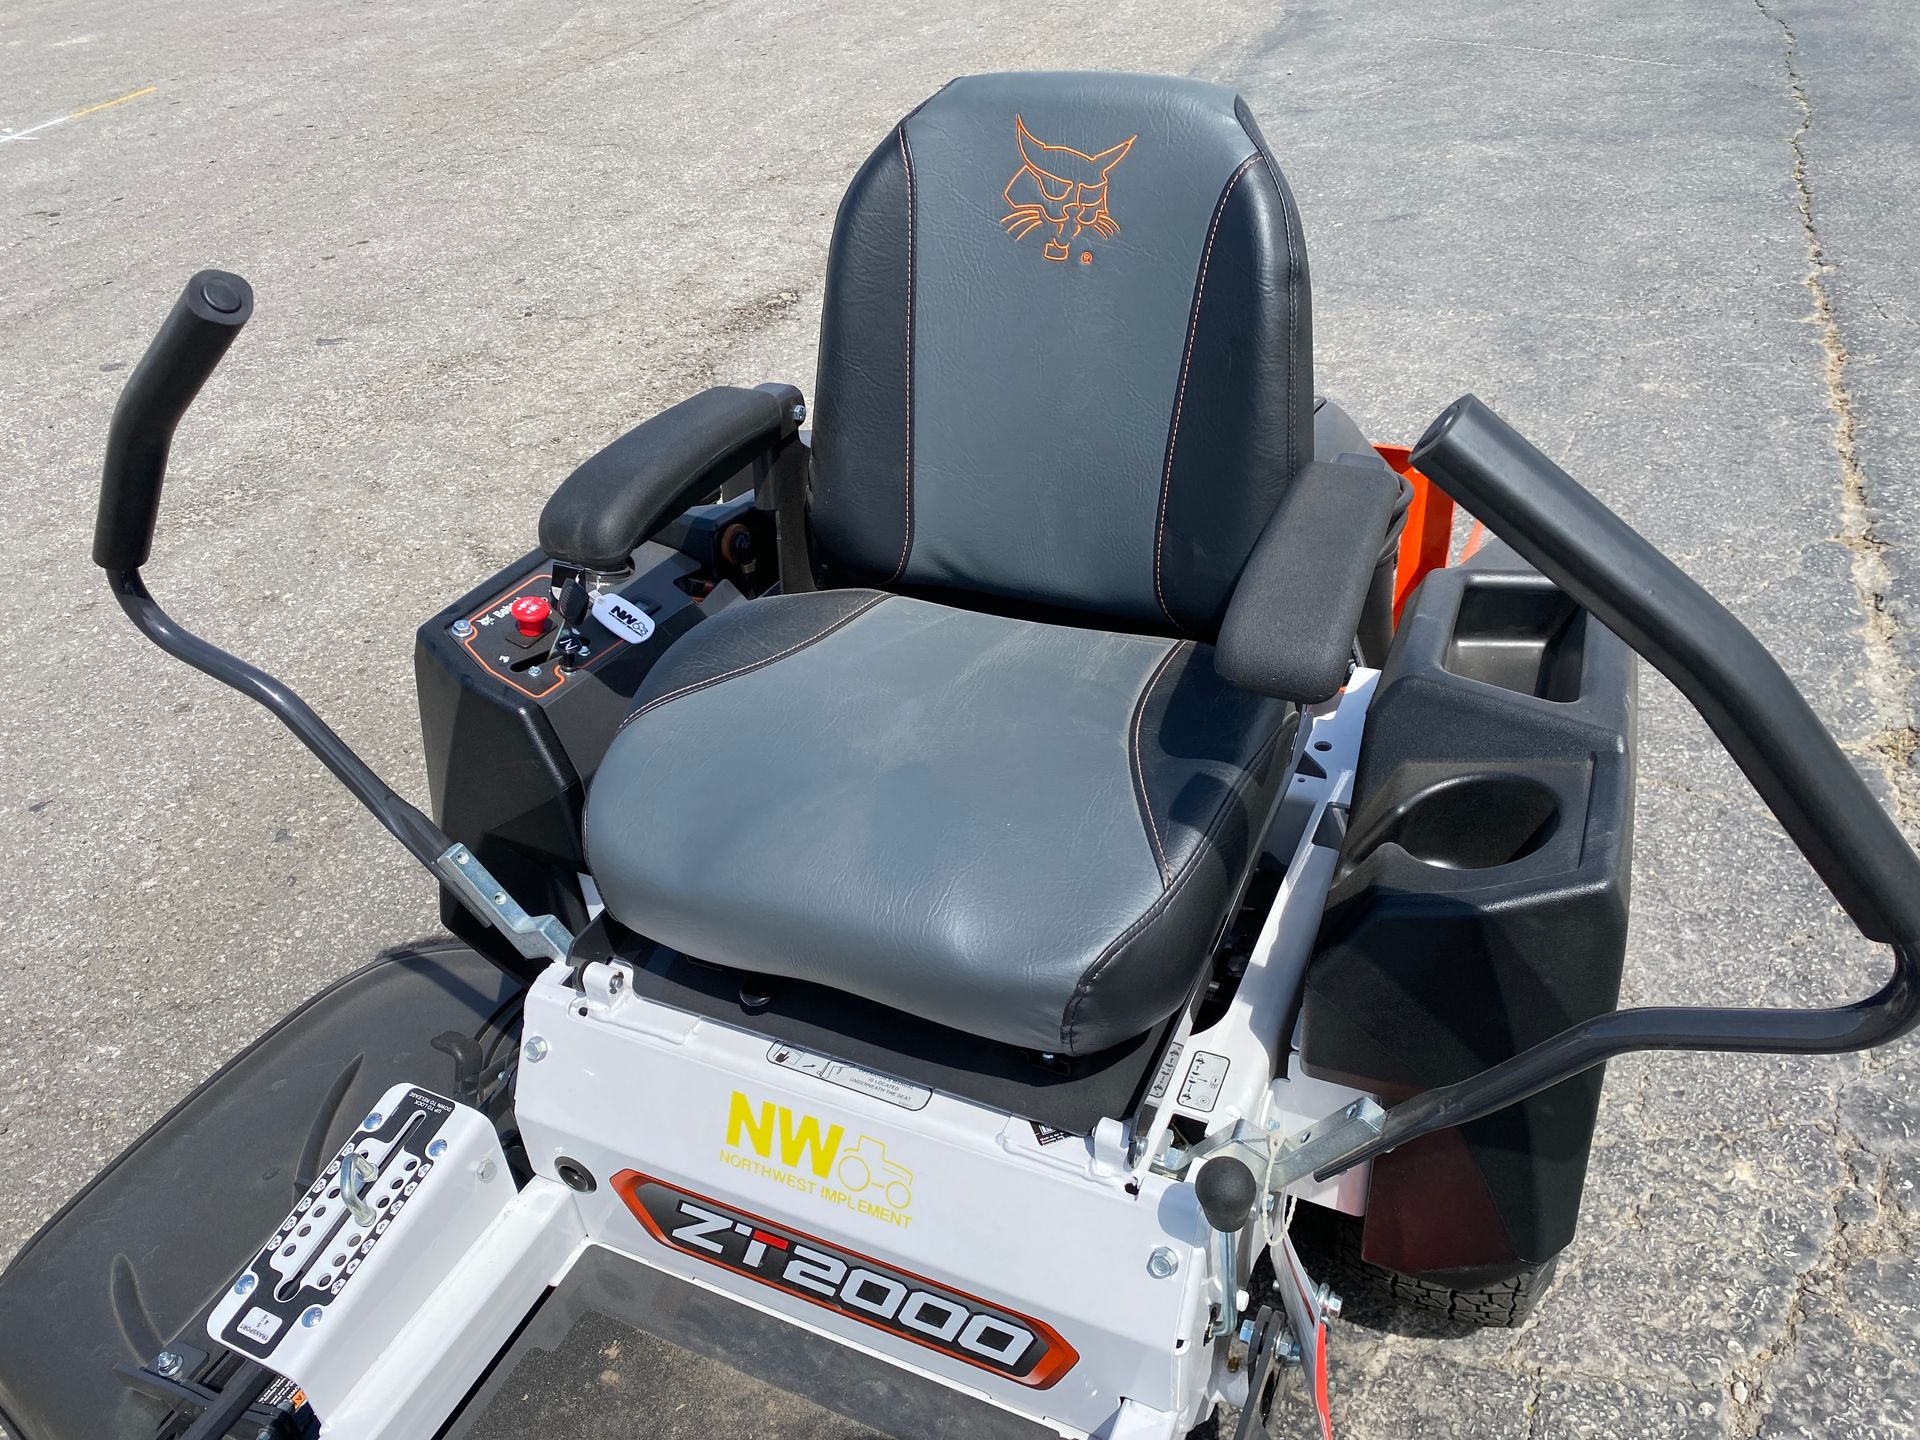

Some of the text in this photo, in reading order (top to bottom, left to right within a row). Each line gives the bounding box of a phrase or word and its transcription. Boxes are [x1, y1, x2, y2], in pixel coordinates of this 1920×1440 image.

[610, 605, 638, 625] NW
[725, 1090, 845, 1180] NW
[719, 1150, 912, 1230] NORTHWEST IMPLEMENT
[671, 1202, 1035, 1368] ZT2000
[240, 1323, 269, 1341] TRANSPORT
